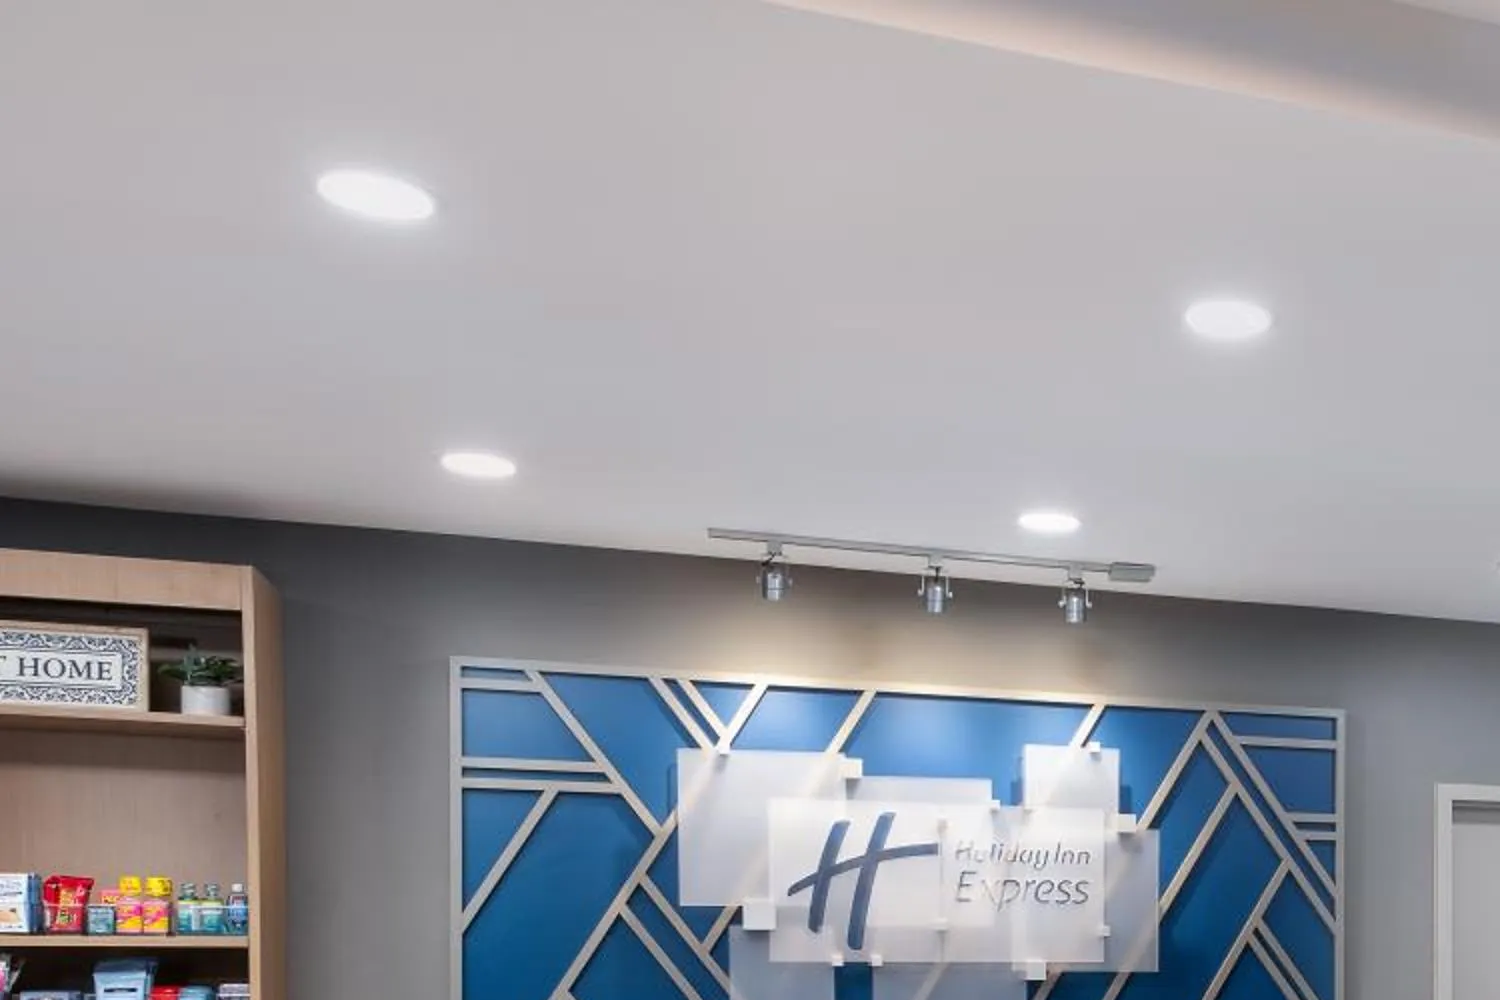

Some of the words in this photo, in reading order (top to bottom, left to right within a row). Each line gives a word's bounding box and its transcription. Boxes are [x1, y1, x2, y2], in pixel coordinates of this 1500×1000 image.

[16, 656, 113, 681] HOME
[955, 842, 1049, 871] Holiday
[1054, 842, 1092, 865] Inn
[955, 870, 1090, 912] Express
